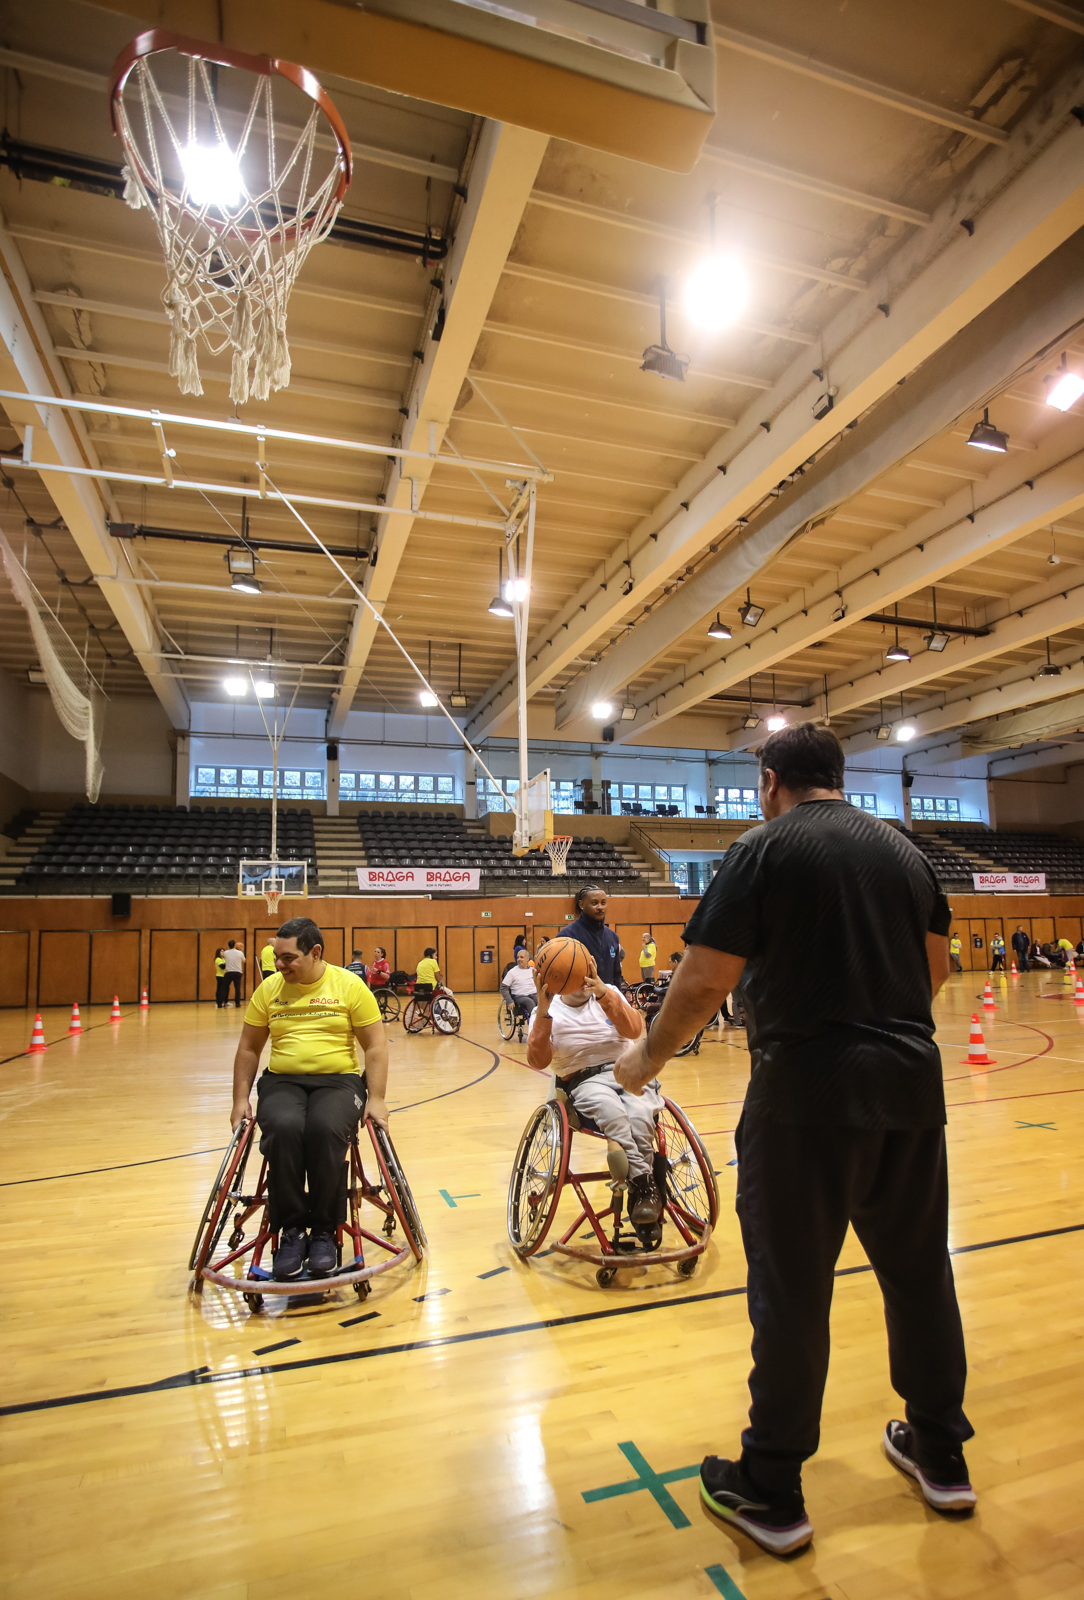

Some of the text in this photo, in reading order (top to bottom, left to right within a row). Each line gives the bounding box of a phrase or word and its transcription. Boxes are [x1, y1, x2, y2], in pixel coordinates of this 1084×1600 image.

[368, 870, 414, 882] BRAGA
[426, 870, 470, 882] BRAGA
[979, 875, 1006, 884] BRAGA
[1013, 875, 1039, 884] BRAGA
